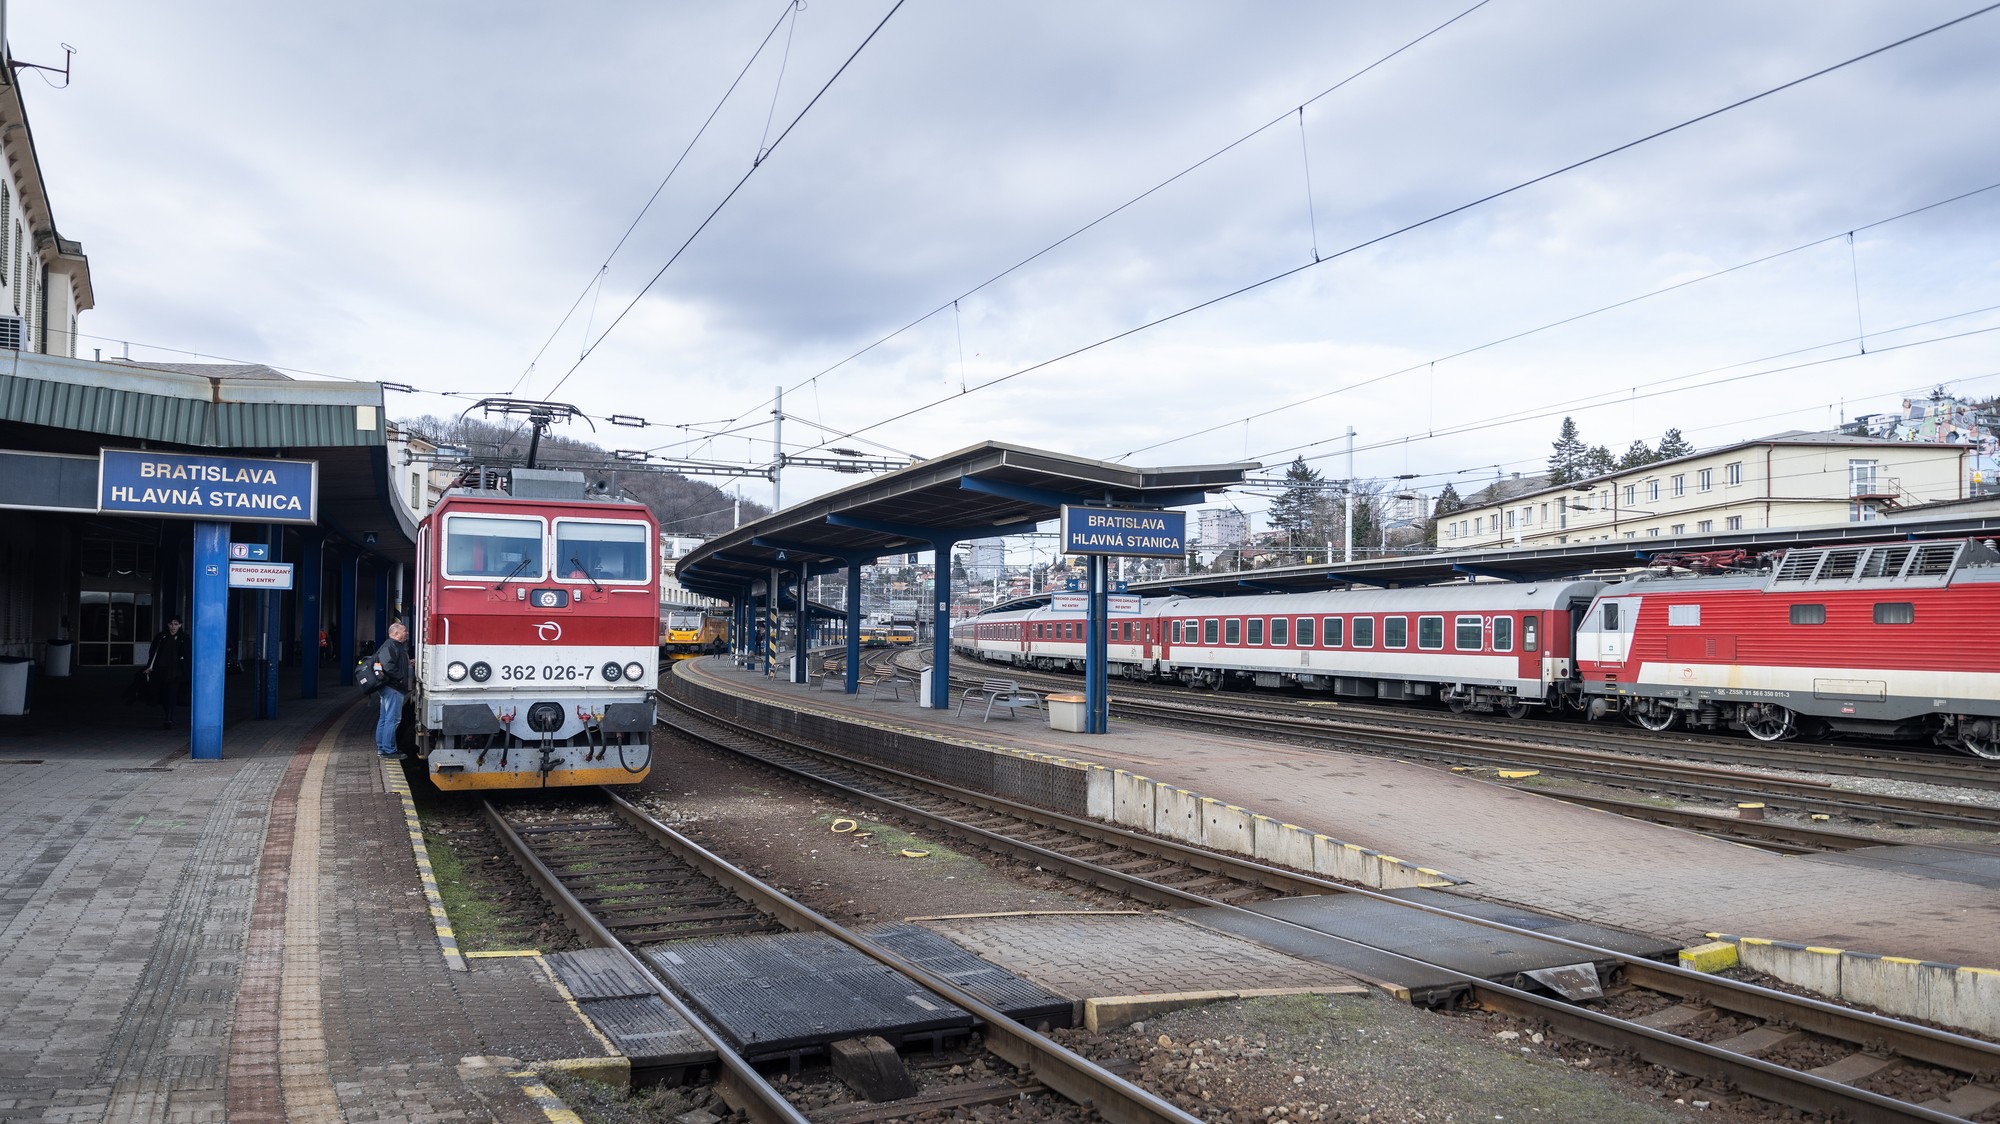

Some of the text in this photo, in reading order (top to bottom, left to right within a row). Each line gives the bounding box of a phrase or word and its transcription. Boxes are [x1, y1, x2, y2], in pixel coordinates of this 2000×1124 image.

[141, 462, 277, 485] BRATISLAVA
[111, 486, 302, 511] HLAVNÁ STANICA
[1088, 515, 1165, 530] BRATISLAVA
[366, 534, 376, 543] A
[1072, 533, 1180, 549] HLAVNÁ STANICA
[778, 551, 786, 559] A
[909, 555, 917, 563] A
[1485, 616, 1491, 629] 2
[501, 665, 595, 681] 362 026-7
